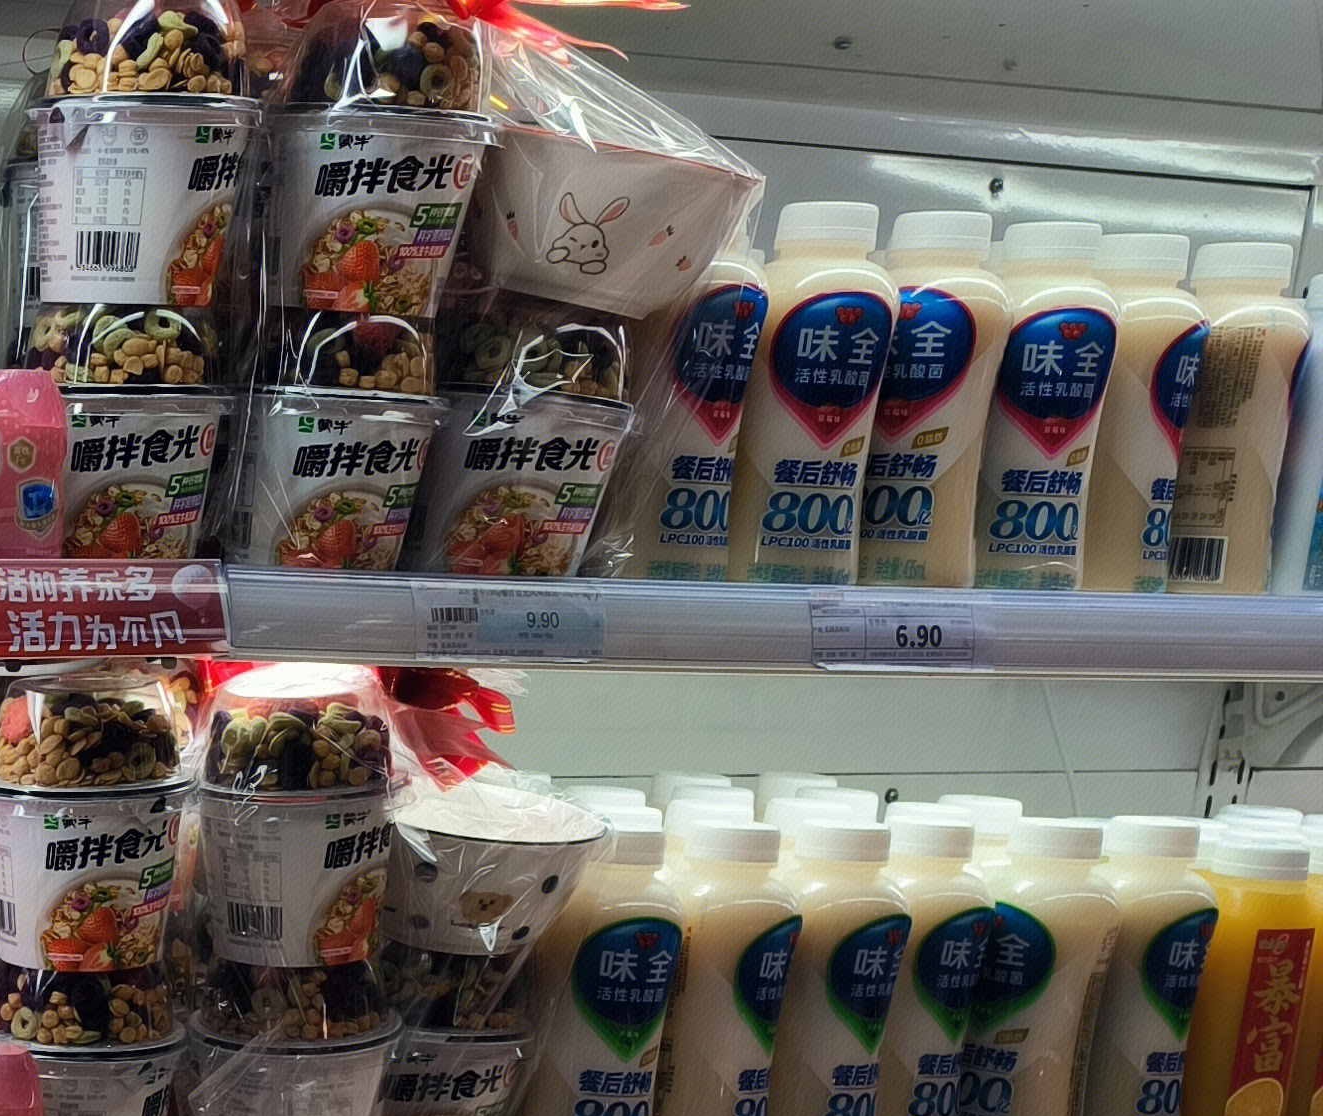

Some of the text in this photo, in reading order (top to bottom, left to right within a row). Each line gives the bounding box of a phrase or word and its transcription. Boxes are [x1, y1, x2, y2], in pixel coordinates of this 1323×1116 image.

[315, 155, 456, 197] 嚼拌食光
[70, 430, 199, 474] 嚼拌食光
[293, 441, 418, 477] 嚼拌食光
[464, 436, 599, 472] 嚼拌食光
[9, 609, 187, 653] 活力为不凡
[526, 611, 559, 630] 9.90
[895, 623, 943, 648] 6.90
[1247, 958, 1302, 1073] 暴富
